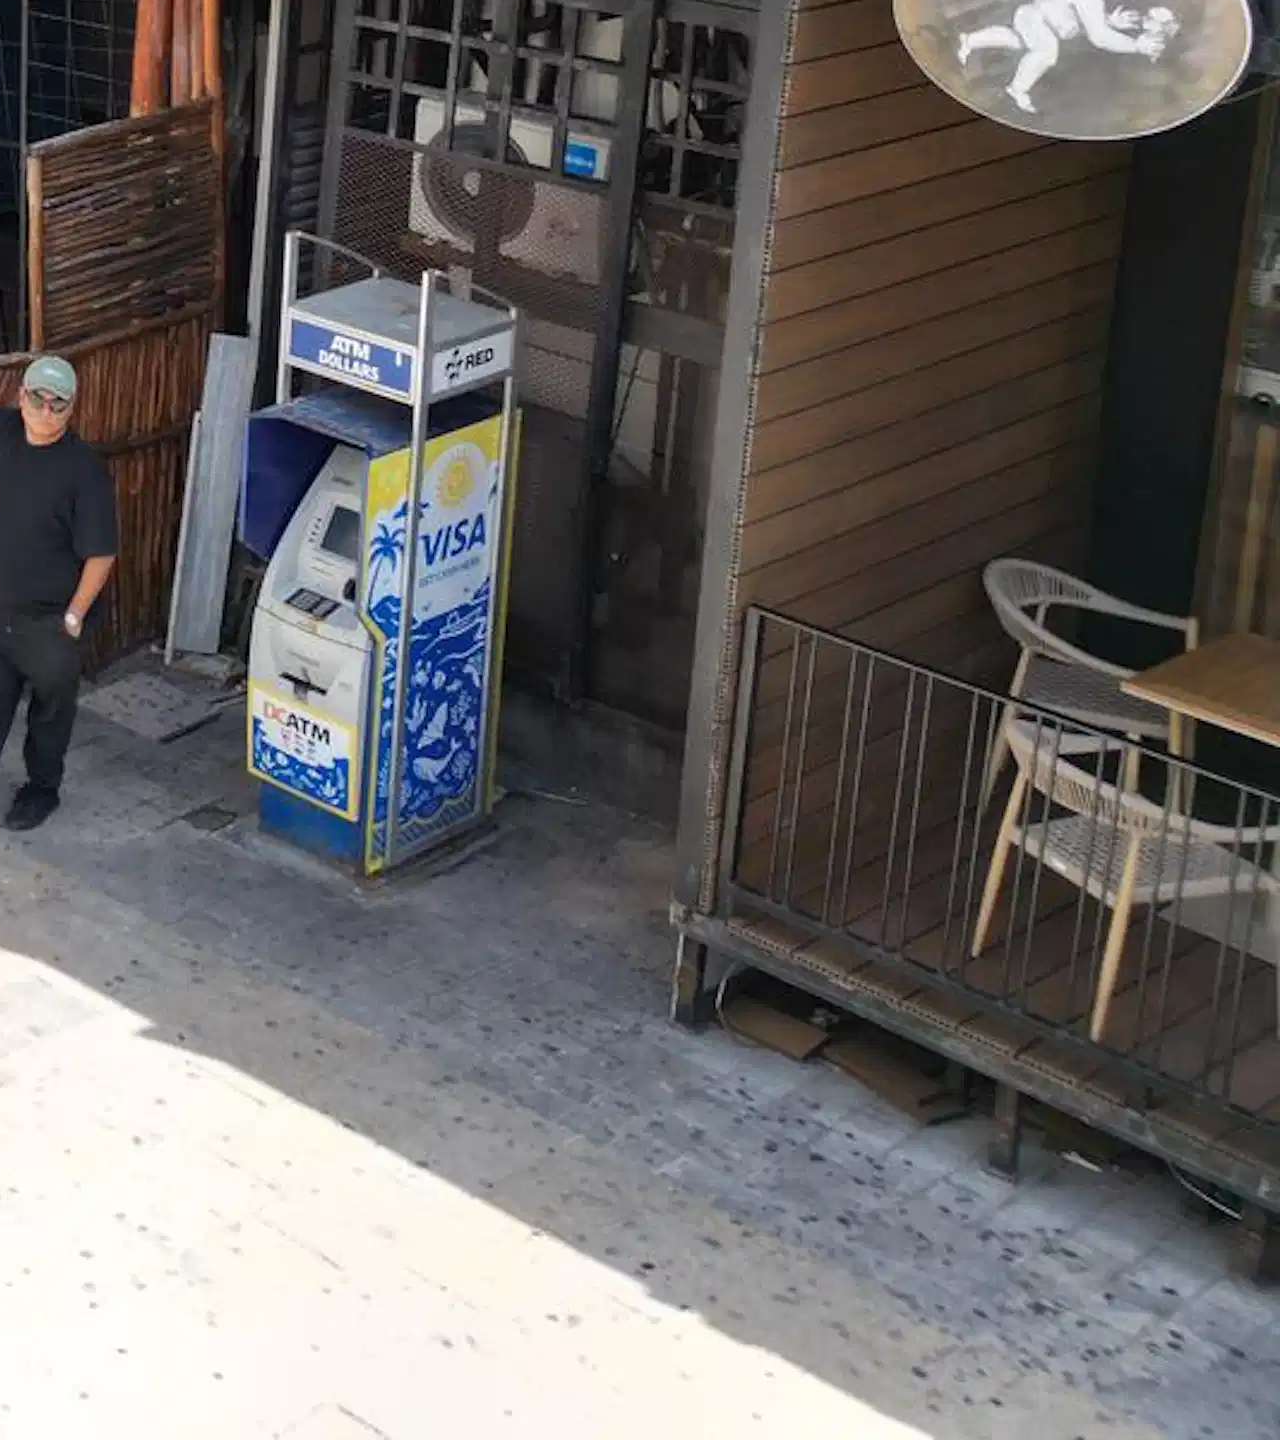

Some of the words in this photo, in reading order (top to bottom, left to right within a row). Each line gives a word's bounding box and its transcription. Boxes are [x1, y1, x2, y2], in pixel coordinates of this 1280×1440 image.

[330, 335, 371, 361] ATM
[464, 347, 495, 371] RED
[318, 349, 380, 382] DOLLARS
[420, 512, 487, 568] VISA
